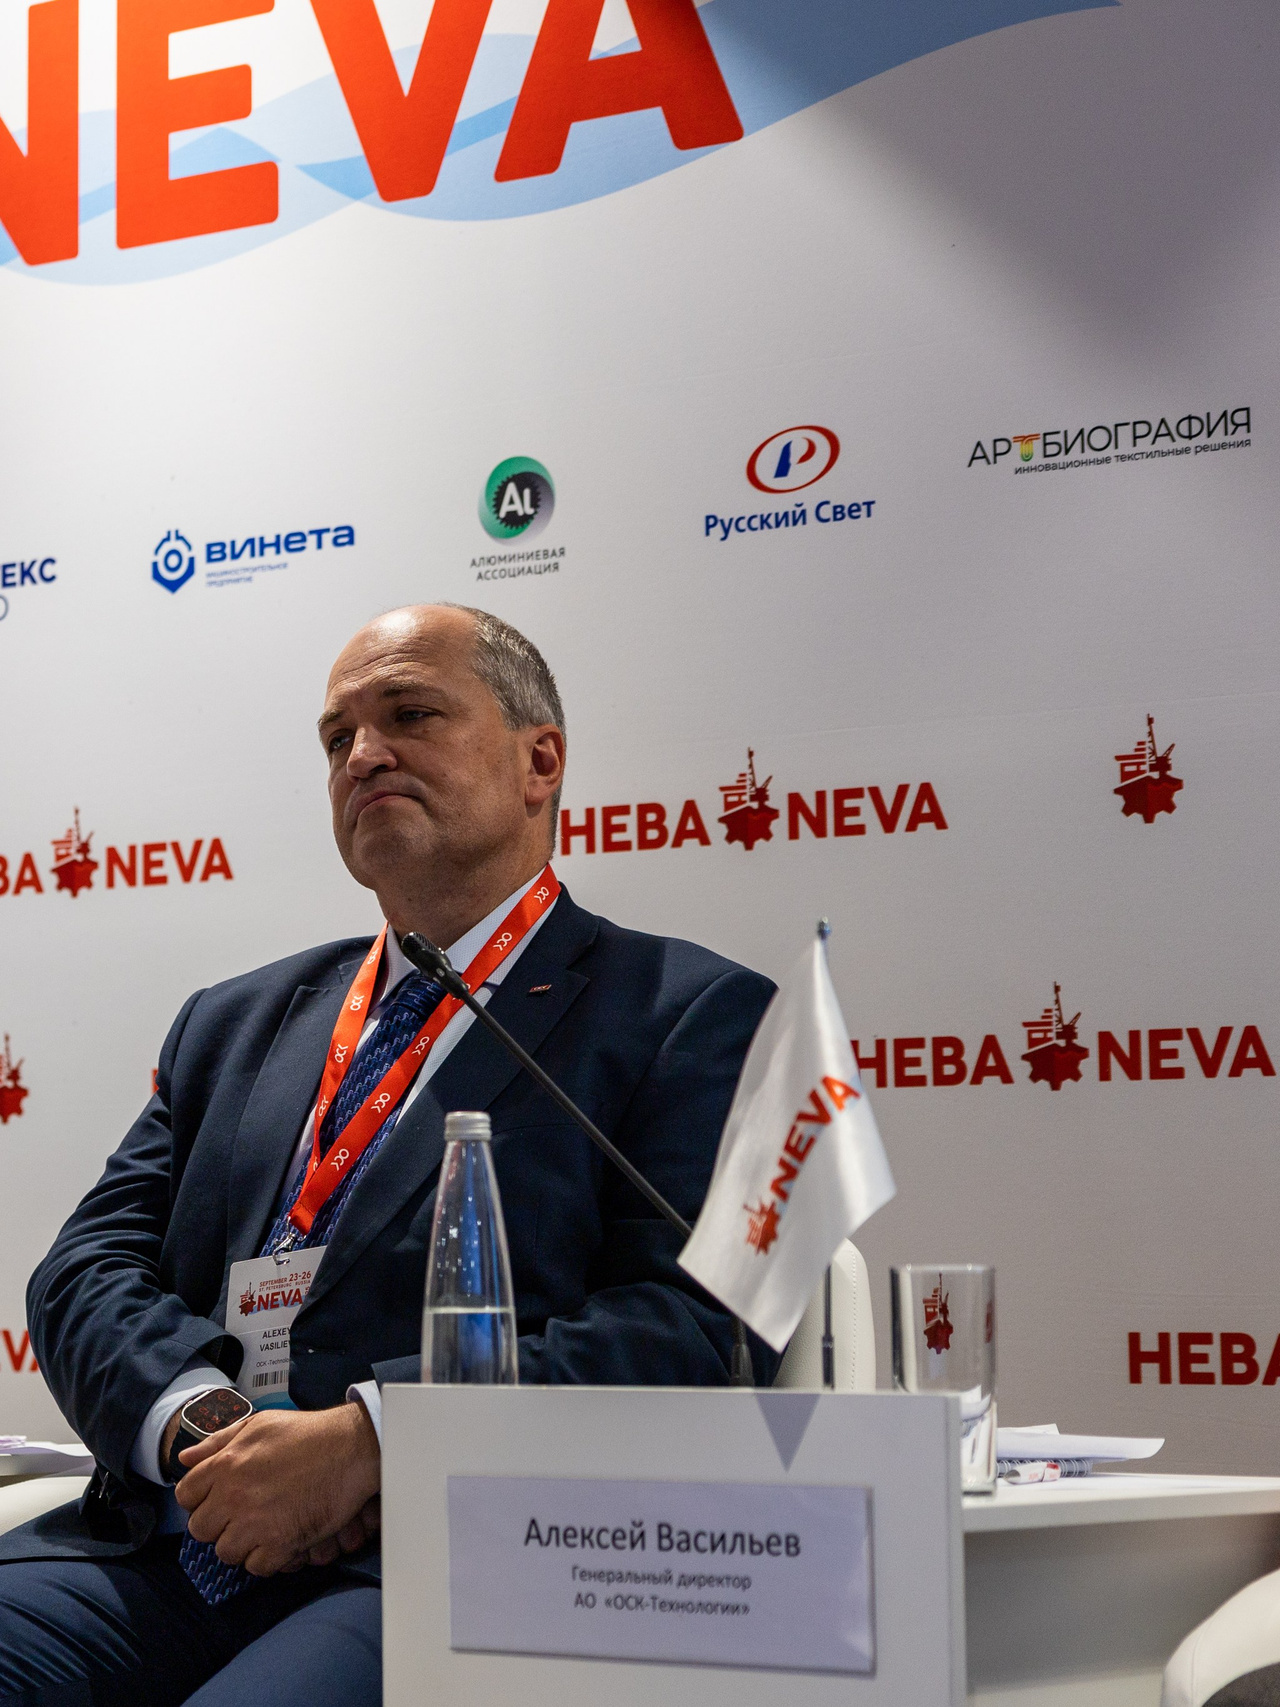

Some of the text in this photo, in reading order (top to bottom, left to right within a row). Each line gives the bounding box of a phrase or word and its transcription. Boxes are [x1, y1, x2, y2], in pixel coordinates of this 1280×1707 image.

[967, 406, 1252, 468] АРТБИОГРАФИЯ
[1014, 437, 1252, 475] инновационные текстильные решения
[704, 499, 876, 542] Русский Свет
[469, 546, 566, 569] АЛЮМИНИЕВАЯ
[475, 561, 560, 582] АССОЦИАЦИЯ
[559, 799, 712, 857] НЕВА
[787, 781, 949, 841] NEVA
[105, 837, 234, 889] NEVA
[850, 1034, 1015, 1089] НЕВА
[1097, 1025, 1276, 1082] NEVA
[770, 1075, 860, 1201] NEVA
[289, 1271, 311, 1282] 23-26
[257, 1288, 303, 1312] NEVA
[523, 1517, 802, 1558] Алексей Васильев
[571, 1564, 753, 1592] Генеральный директор
[573, 1591, 751, 1617] АО «ОСК-Технологии»
